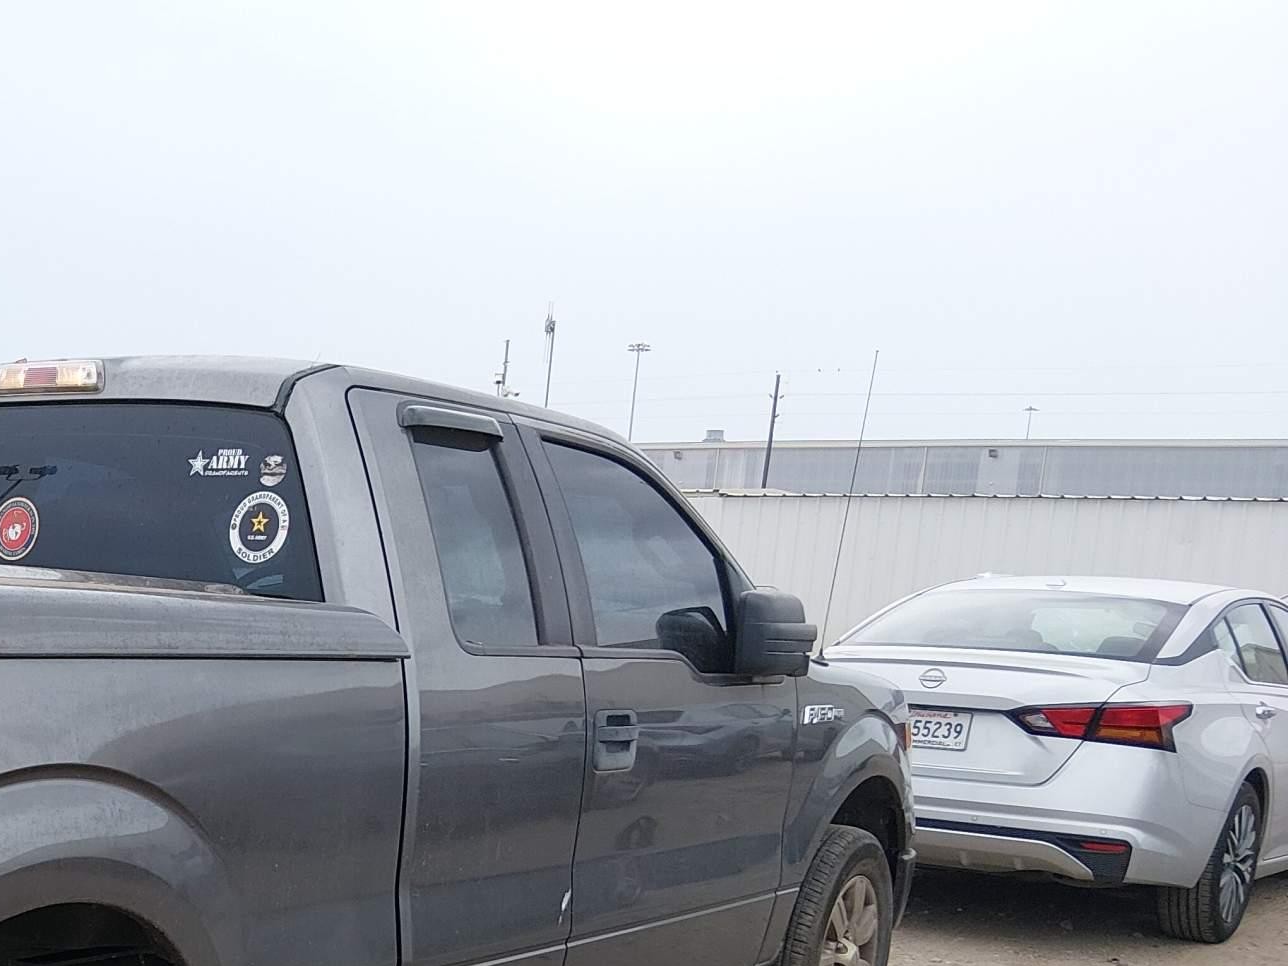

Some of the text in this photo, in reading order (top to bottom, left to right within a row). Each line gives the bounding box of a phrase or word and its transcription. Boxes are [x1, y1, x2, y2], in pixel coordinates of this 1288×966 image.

[217, 448, 243, 457] PROUD
[207, 455, 250, 469] ARMY
[233, 502, 248, 523] PROUD
[247, 493, 284, 510] GRANDPARENT
[236, 547, 275, 562] SOLDIER
[912, 719, 963, 740] 55239
